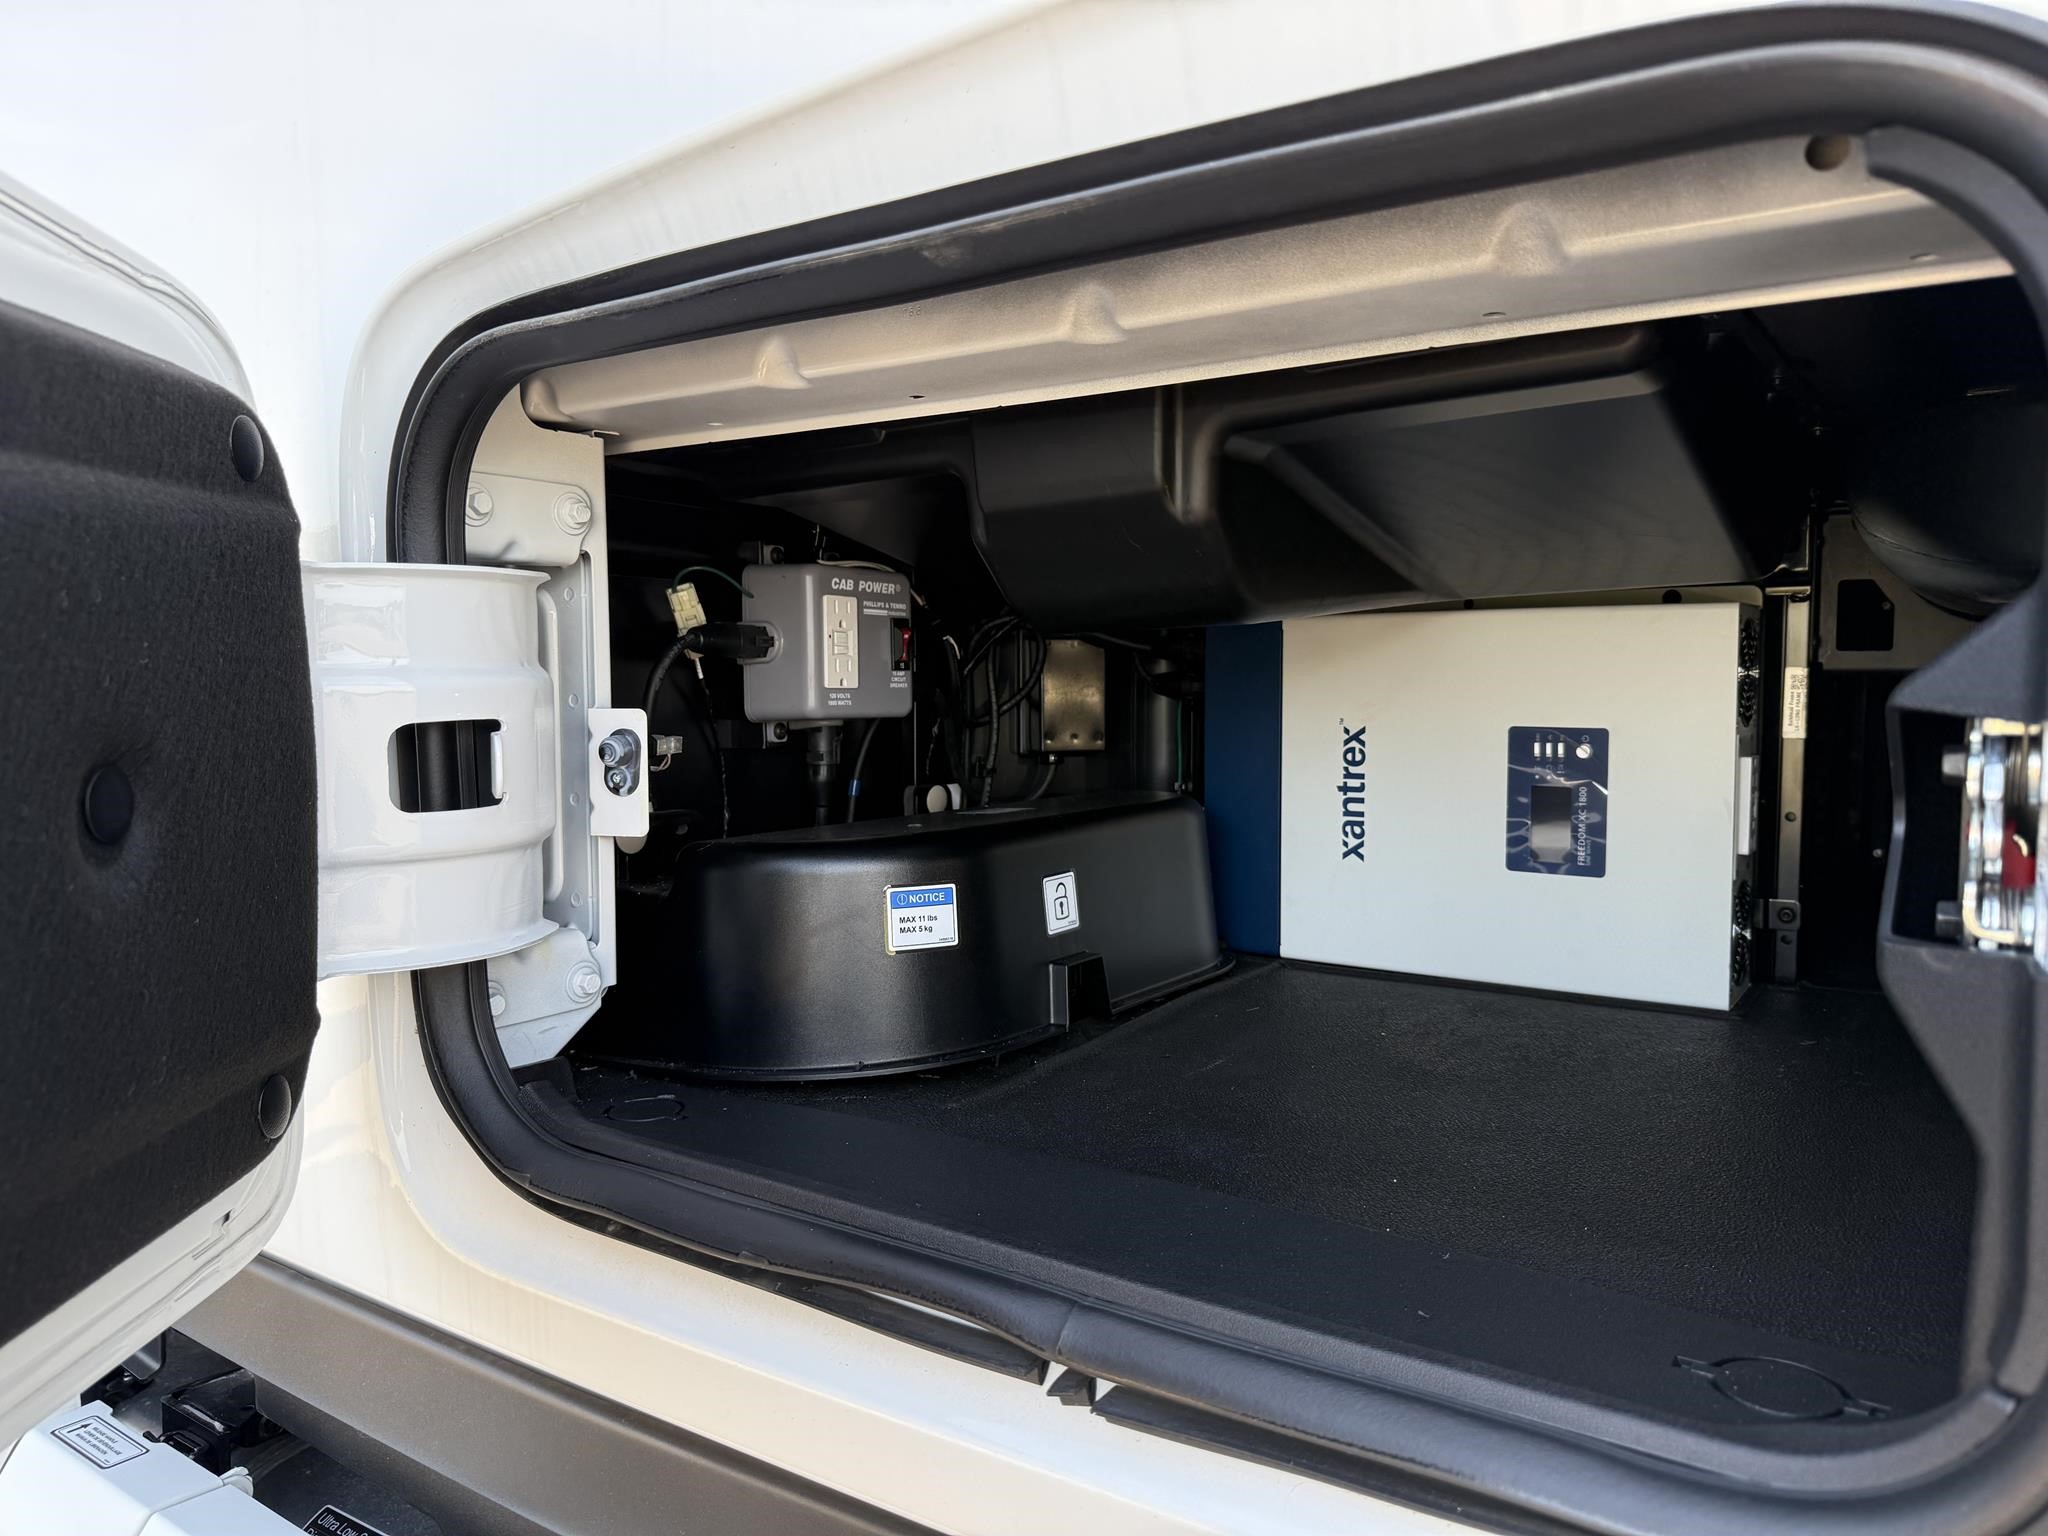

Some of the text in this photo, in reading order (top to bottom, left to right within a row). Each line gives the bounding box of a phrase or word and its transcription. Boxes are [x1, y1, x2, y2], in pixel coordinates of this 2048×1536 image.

[831, 577, 854, 590] CAB
[1578, 786, 1588, 807] 1800
[1577, 823, 1587, 866] FREEDOM
[909, 892, 945, 903] NOTICE
[899, 916, 917, 924] MAX
[899, 926, 917, 934] MAX
[924, 925, 933, 933] kg
[317, 1512, 341, 1531] Ultra
